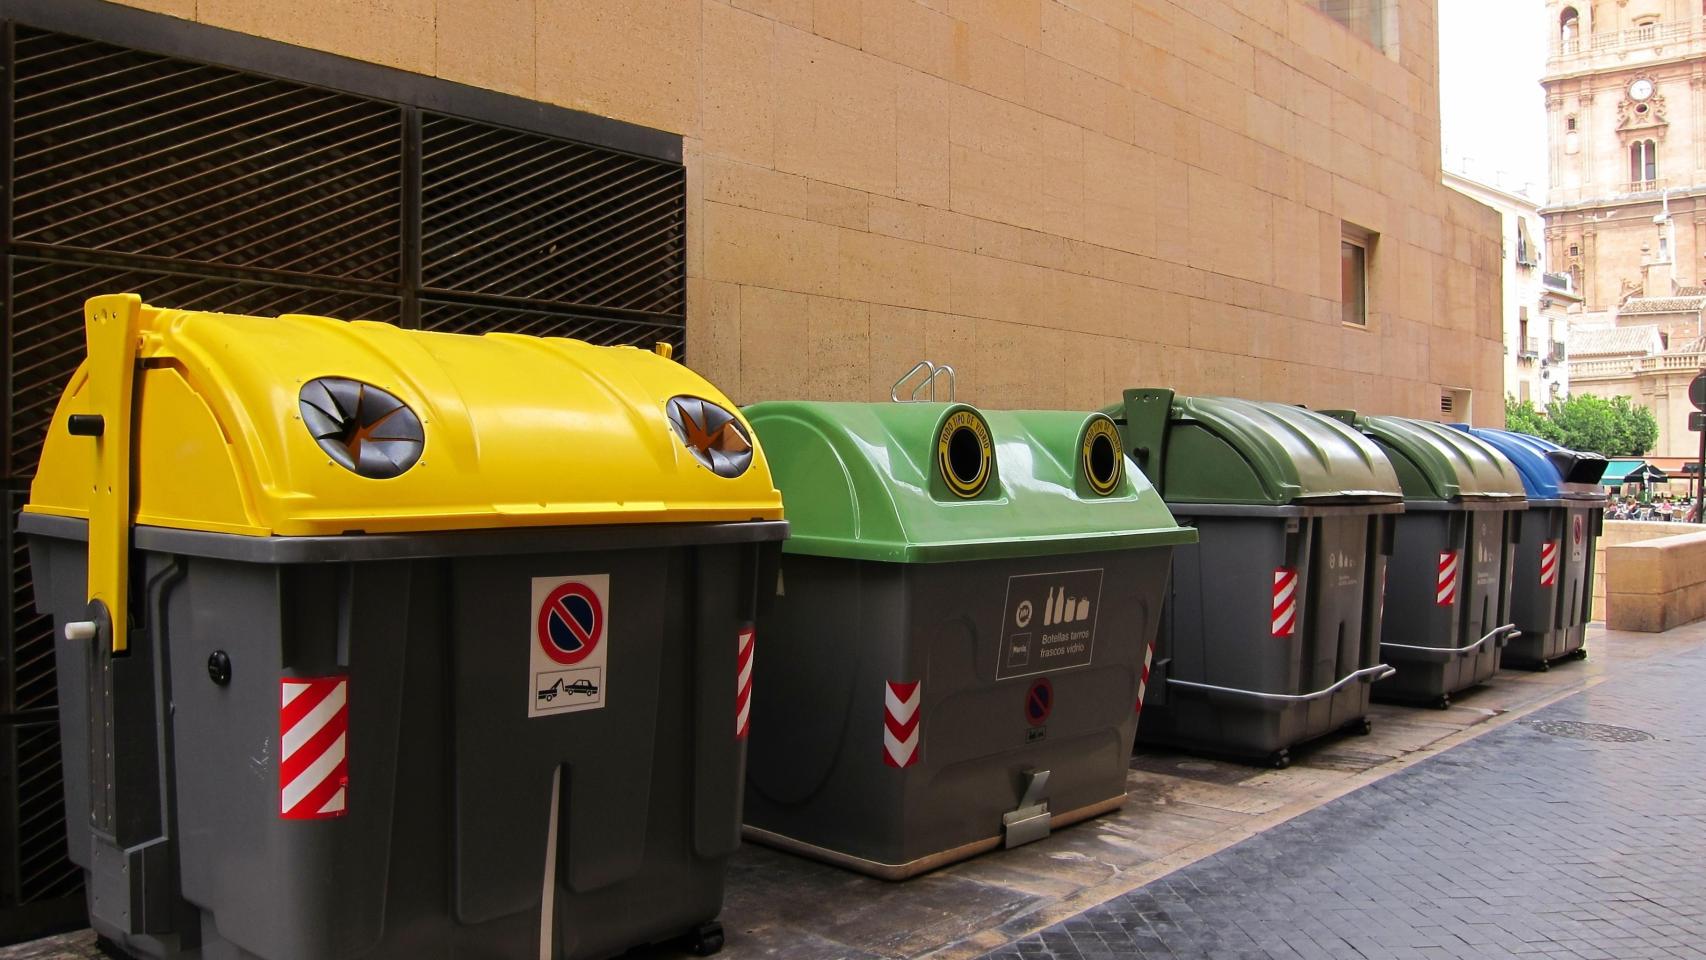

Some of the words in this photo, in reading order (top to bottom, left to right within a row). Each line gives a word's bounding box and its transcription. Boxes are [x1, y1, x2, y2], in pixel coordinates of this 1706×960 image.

[942, 422, 954, 444] TODO
[966, 414, 976, 426] DE
[975, 421, 990, 449] VIDRIO
[1042, 632, 1069, 645] Botellas
[1070, 630, 1089, 640] tarros
[1040, 647, 1065, 658] frascos
[1066, 643, 1085, 654] vidrio
